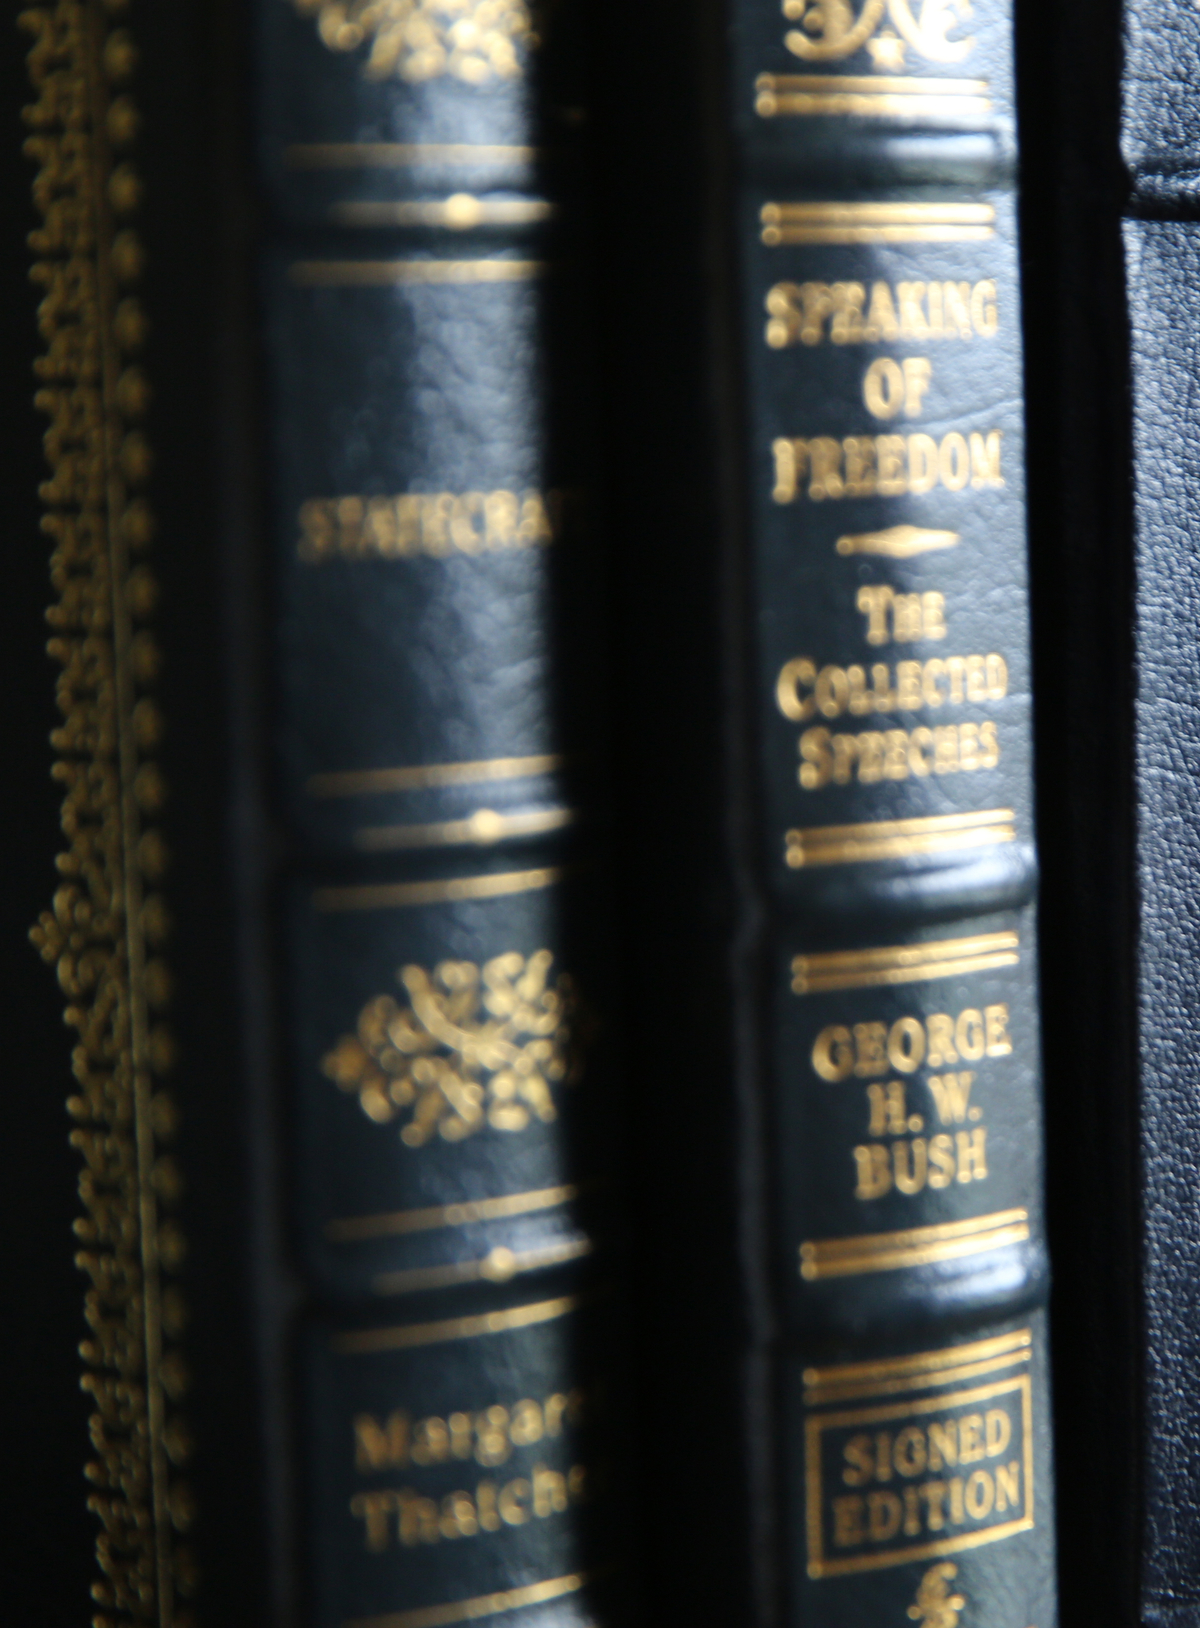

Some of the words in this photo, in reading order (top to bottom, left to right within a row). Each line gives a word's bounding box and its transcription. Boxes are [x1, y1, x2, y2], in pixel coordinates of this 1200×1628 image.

[765, 278, 1000, 348] SPEAKING
[862, 356, 933, 420] OF
[771, 430, 1004, 504] FREEDOM
[810, 1004, 1013, 1082] GEORGE
[867, 1083, 923, 1135] H.
[927, 1072, 982, 1126] W.
[854, 1128, 988, 1199] BUSH
[843, 1409, 1013, 1486] SIGNED
[831, 1462, 1021, 1547] EDITION
